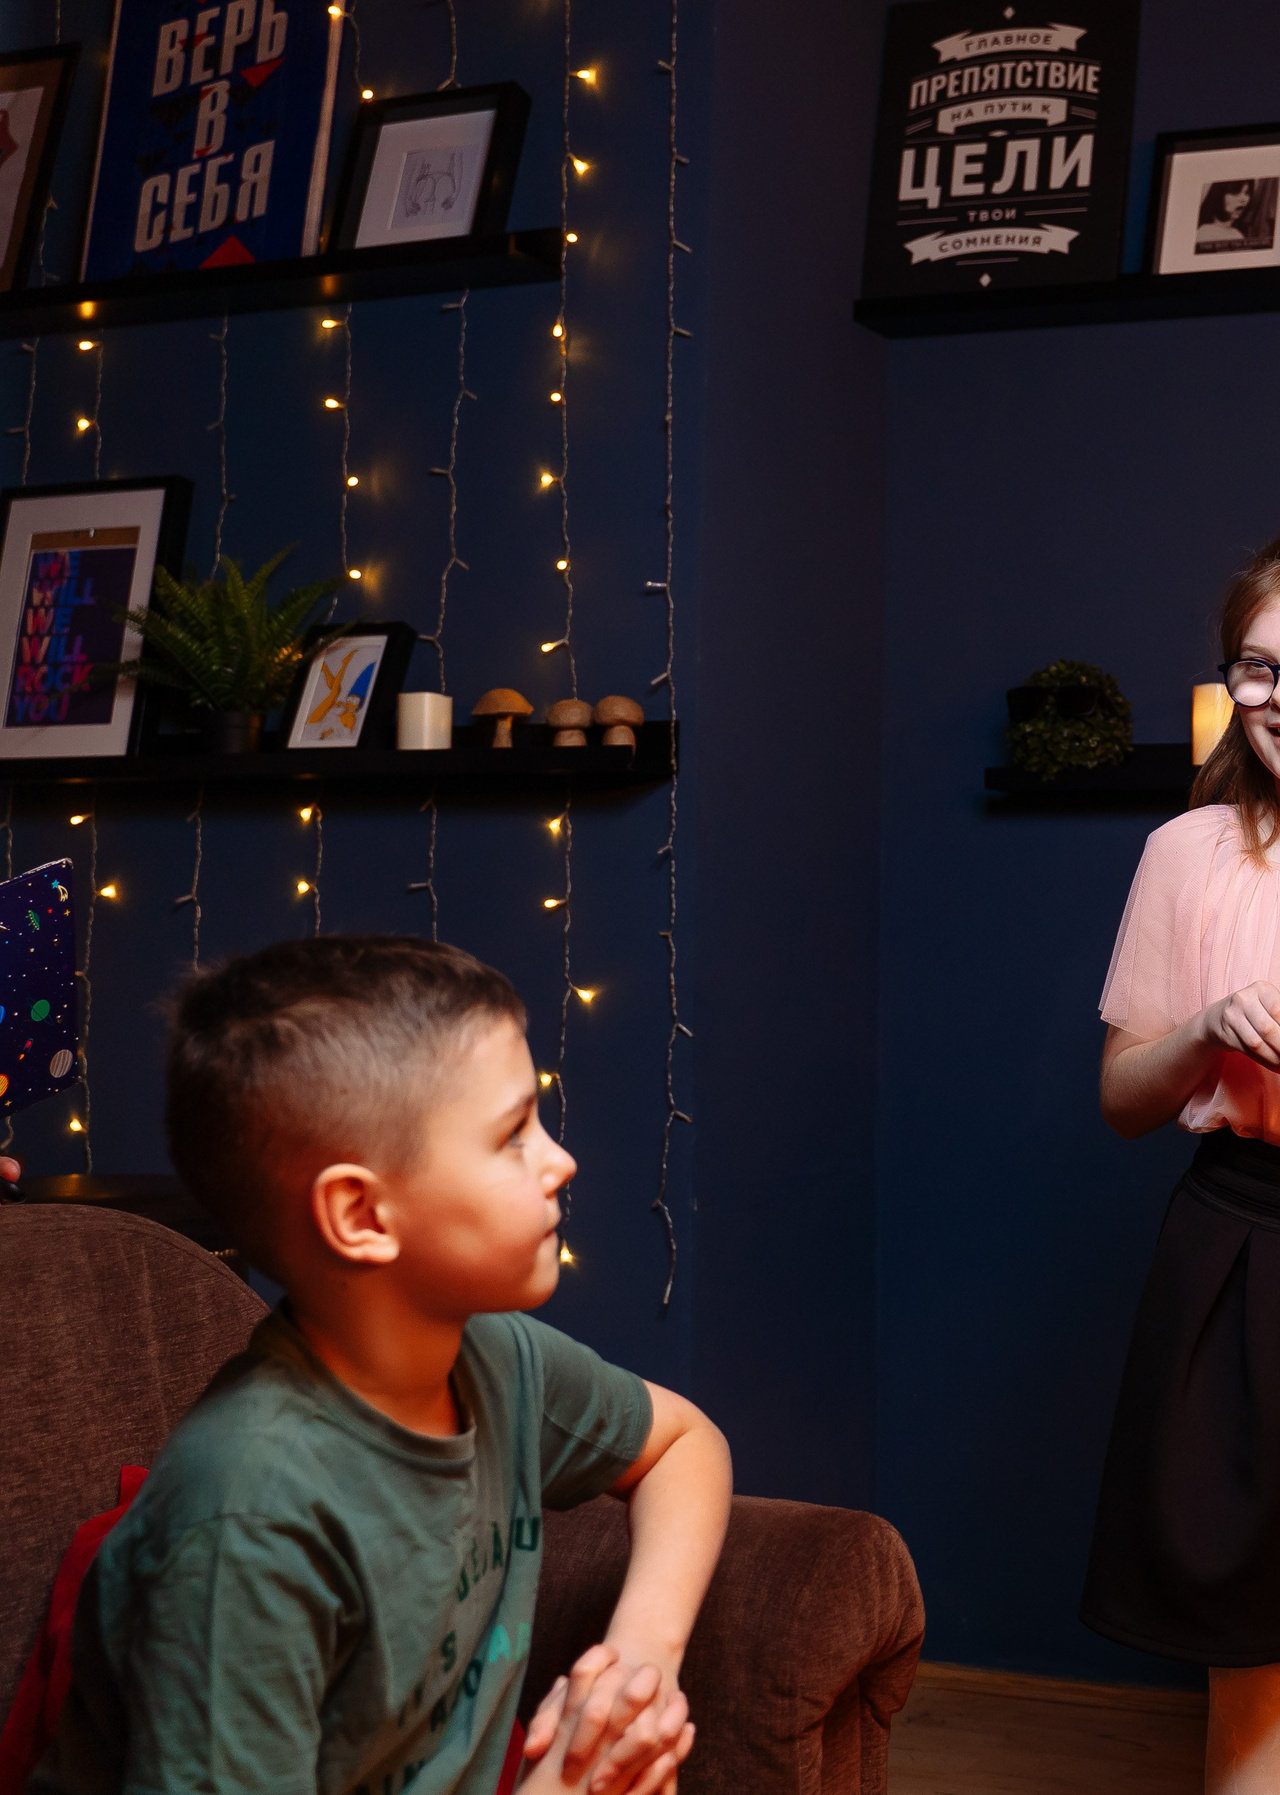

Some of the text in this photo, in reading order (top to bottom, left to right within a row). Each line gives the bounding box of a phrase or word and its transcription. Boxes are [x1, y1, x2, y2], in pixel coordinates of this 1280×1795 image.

[153, 0, 288, 97] ВЕРЬ
[964, 34, 1053, 52] ГЛАВНОЕ
[909, 60, 1101, 110] ПРЕПЯТСТВИЕ
[193, 80, 231, 160] В
[950, 102, 1052, 123] НА ПУТИ К
[898, 133, 1094, 209] ЦЕЛИ
[134, 140, 275, 253] СЕБЯ
[966, 208, 1017, 223] ТВОИ
[938, 235, 1044, 253] СОМНЕНИЯ
[26, 608, 73, 636] WE
[21, 635, 89, 664] WILL
[16, 664, 93, 693] ROCK
[14, 692, 71, 723] YOU
